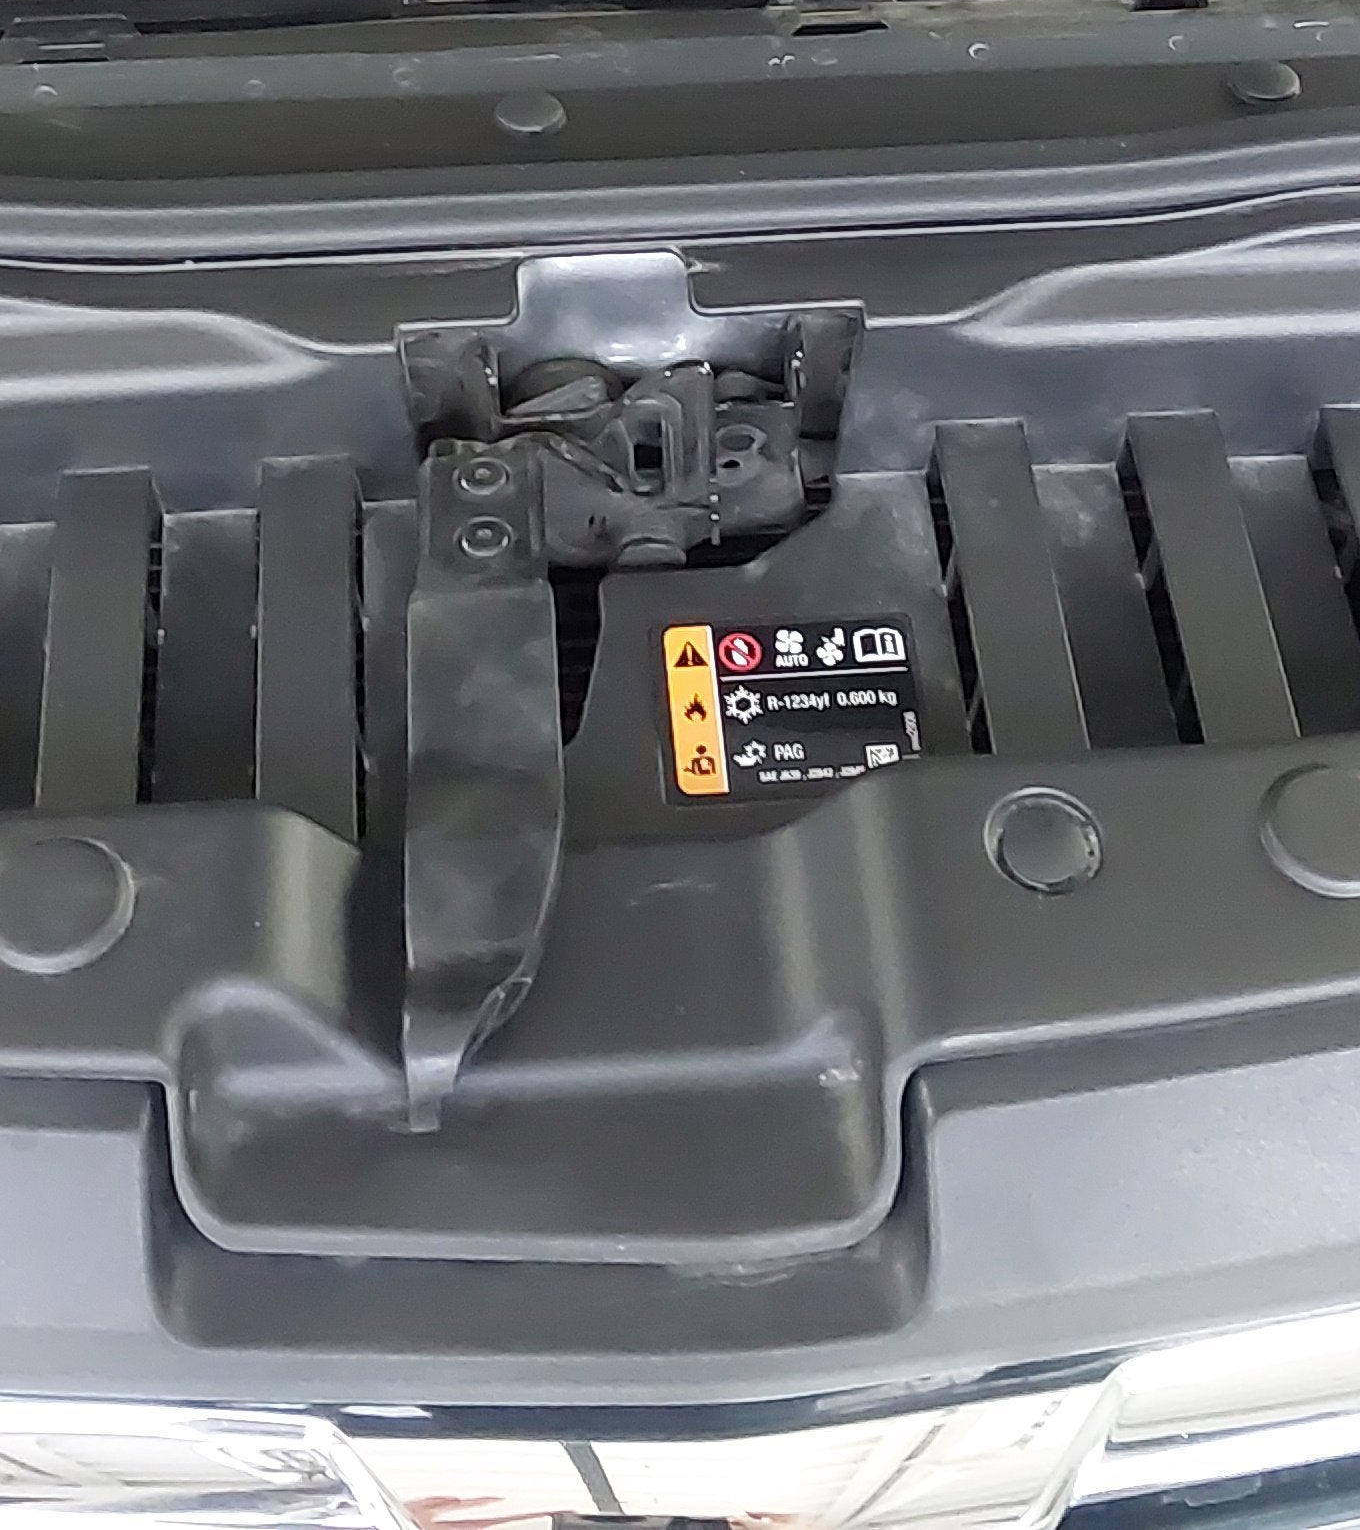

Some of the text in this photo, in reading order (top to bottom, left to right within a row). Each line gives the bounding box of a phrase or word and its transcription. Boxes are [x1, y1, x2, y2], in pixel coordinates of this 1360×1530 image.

[775, 653, 809, 668] AUTO
[836, 690, 877, 707] 0.600
[877, 689, 898, 707] kg
[773, 743, 805, 761] PAG
